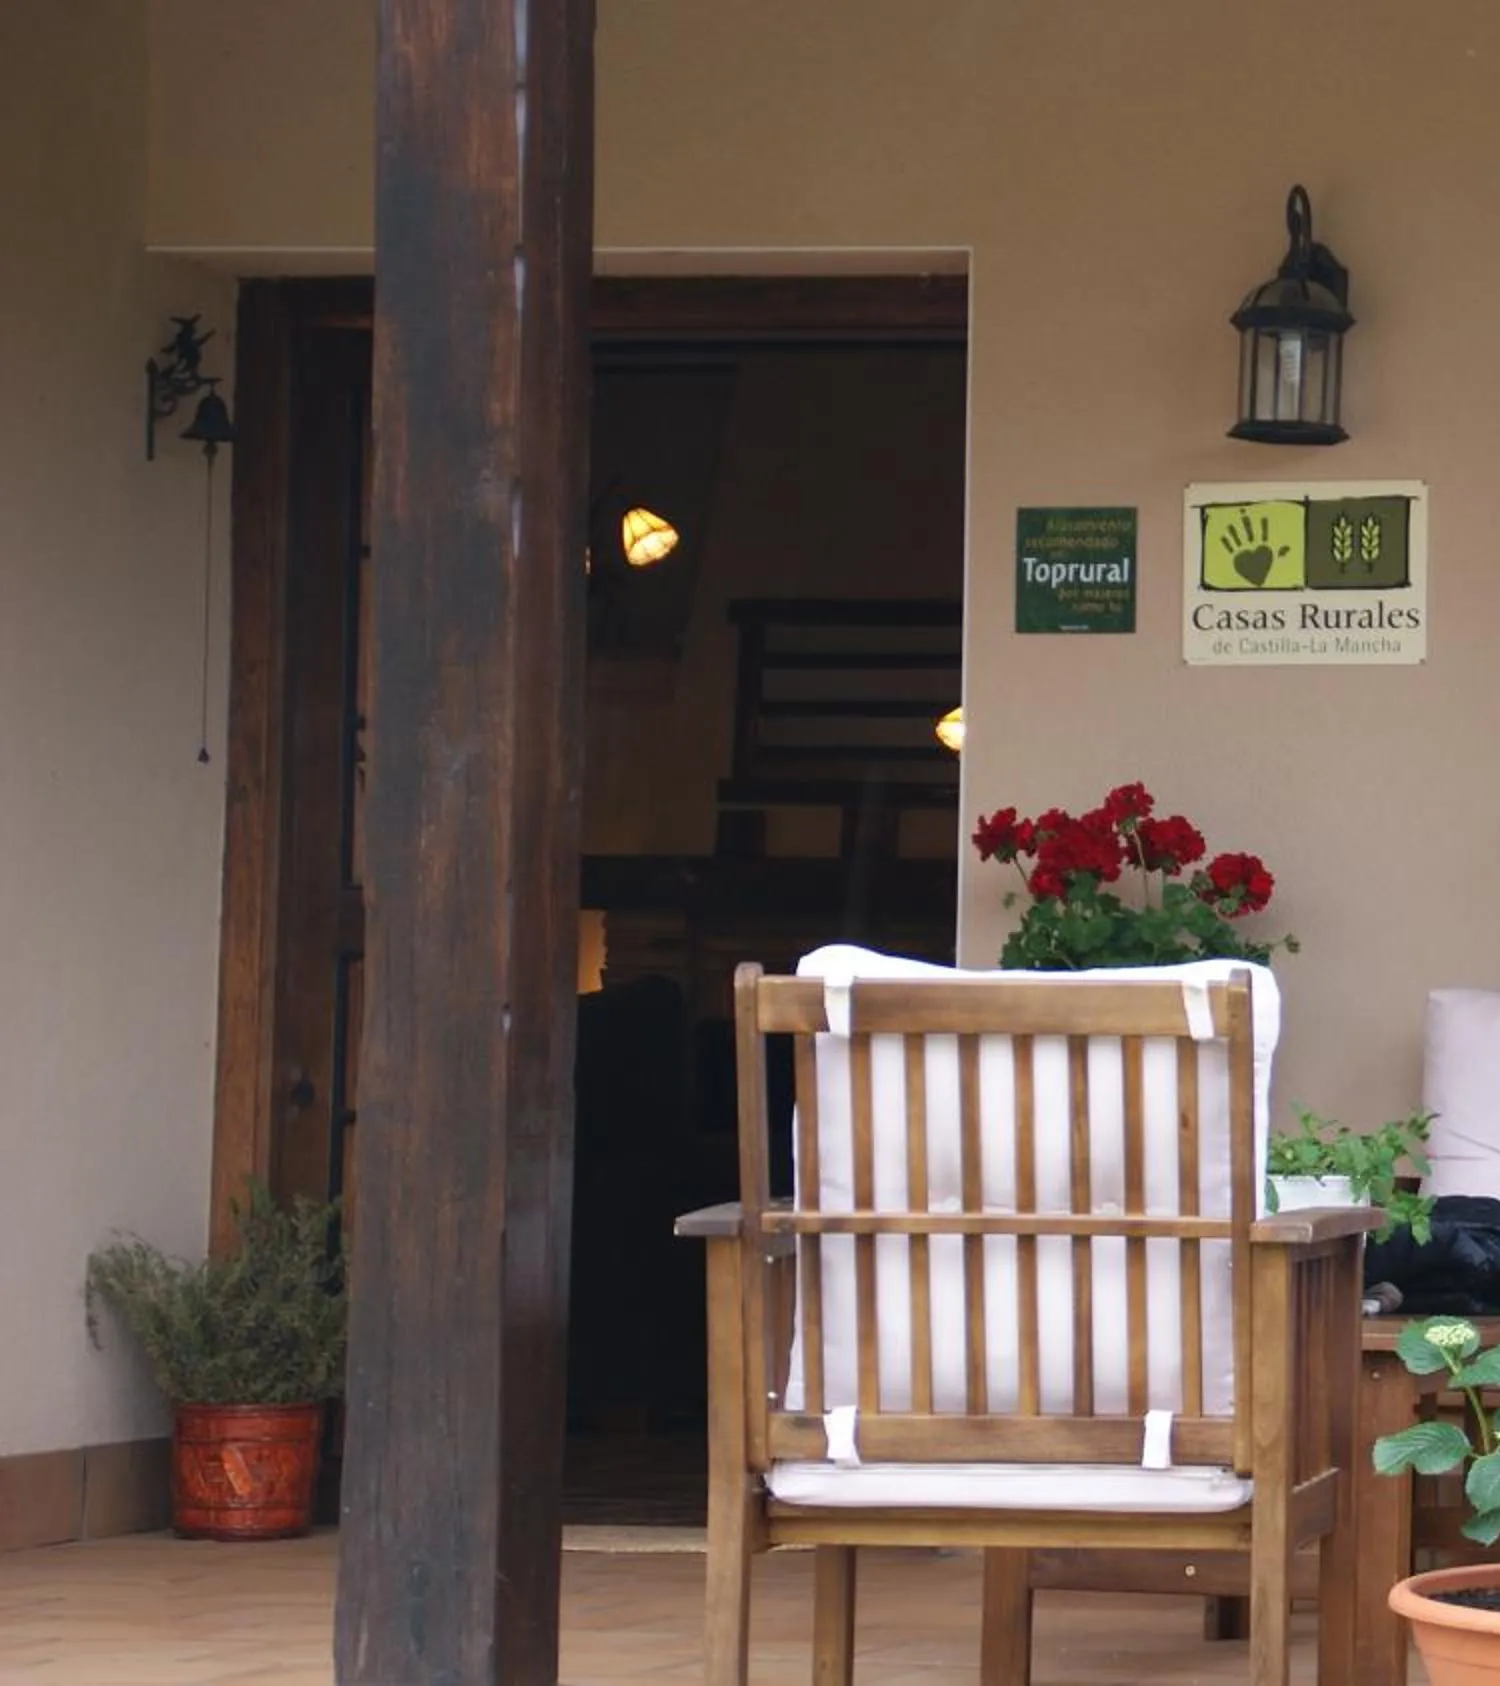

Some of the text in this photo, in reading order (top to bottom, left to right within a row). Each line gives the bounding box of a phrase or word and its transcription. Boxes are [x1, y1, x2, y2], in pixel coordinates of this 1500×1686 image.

[1023, 557, 1129, 588] Toprural
[1192, 600, 1420, 631] Casas Rurales
[1213, 637, 1232, 655] de
[1335, 636, 1402, 654] Mancha
